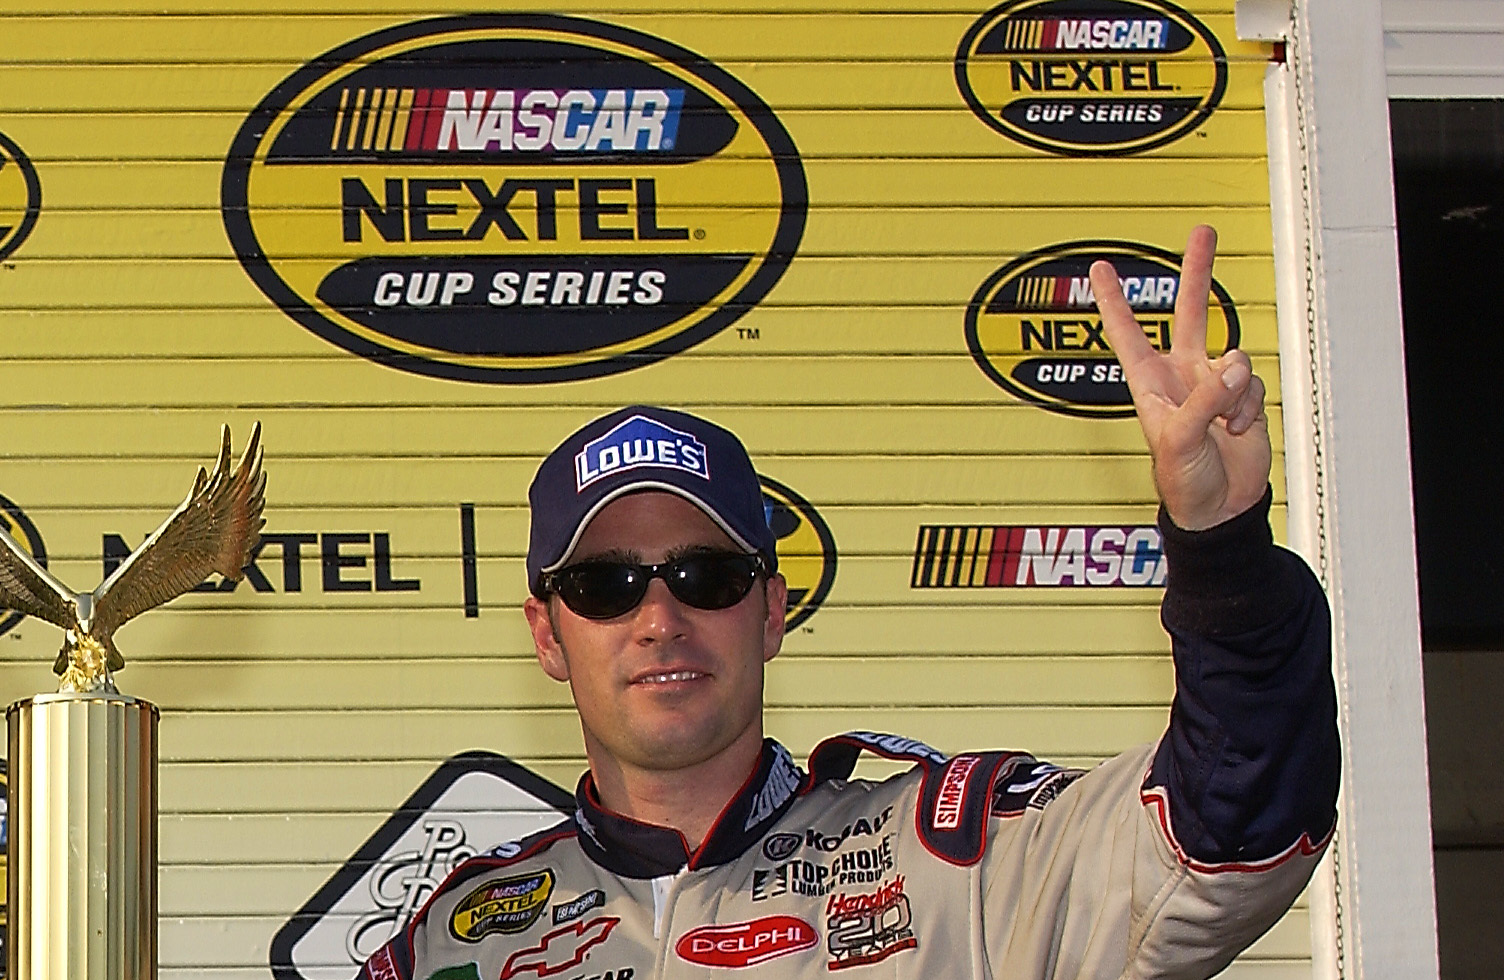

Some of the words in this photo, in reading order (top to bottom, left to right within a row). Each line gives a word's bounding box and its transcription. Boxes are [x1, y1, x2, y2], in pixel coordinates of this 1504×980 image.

[1055, 21, 1162, 49] NASCAR
[1010, 61, 1173, 91] NEXTEL
[438, 89, 670, 150] NASCAR
[1026, 105, 1076, 123] CUP
[1080, 104, 1162, 123] SERIES
[341, 178, 689, 242] NEXTEL
[374, 273, 474, 306] CUP
[488, 271, 666, 305] SERIES
[1068, 277, 1176, 307] NCAR
[1037, 365, 1086, 383] CUP
[580, 439, 701, 483] LOWE'S
[1015, 528, 1164, 586] NASC
[937, 757, 976, 824] SIMPSON
[805, 805, 894, 852] KOALT
[790, 860, 829, 884] TOP
[831, 835, 891, 877] CHOIE
[839, 856, 893, 885] PRODUTS
[470, 893, 538, 924] NEXTEL
[826, 874, 906, 918] Hendrick
[691, 927, 801, 954] DELPHI
